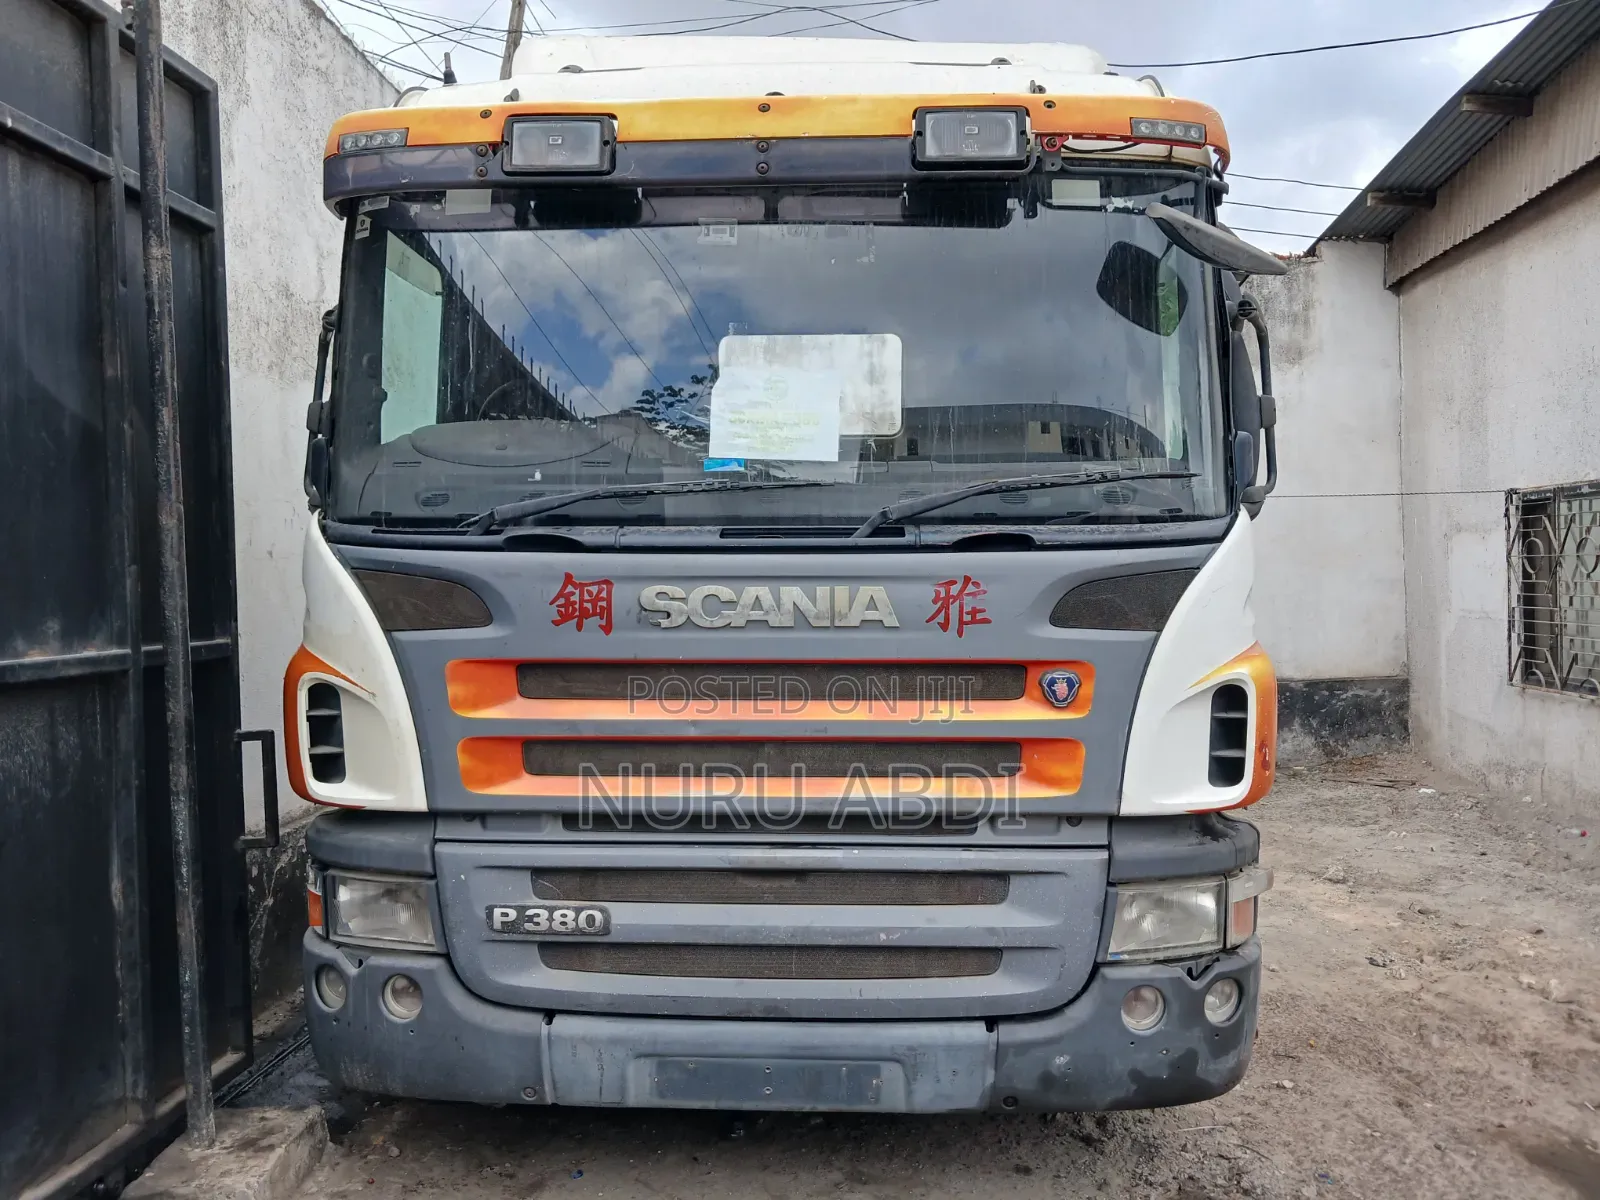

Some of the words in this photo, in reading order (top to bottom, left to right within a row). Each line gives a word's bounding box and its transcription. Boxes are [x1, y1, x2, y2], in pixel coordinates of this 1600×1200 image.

[549, 571, 614, 636] 鋼
[638, 585, 900, 629] SCANIA
[925, 574, 992, 638] 雅
[493, 907, 517, 931] P
[523, 908, 604, 933] 380
